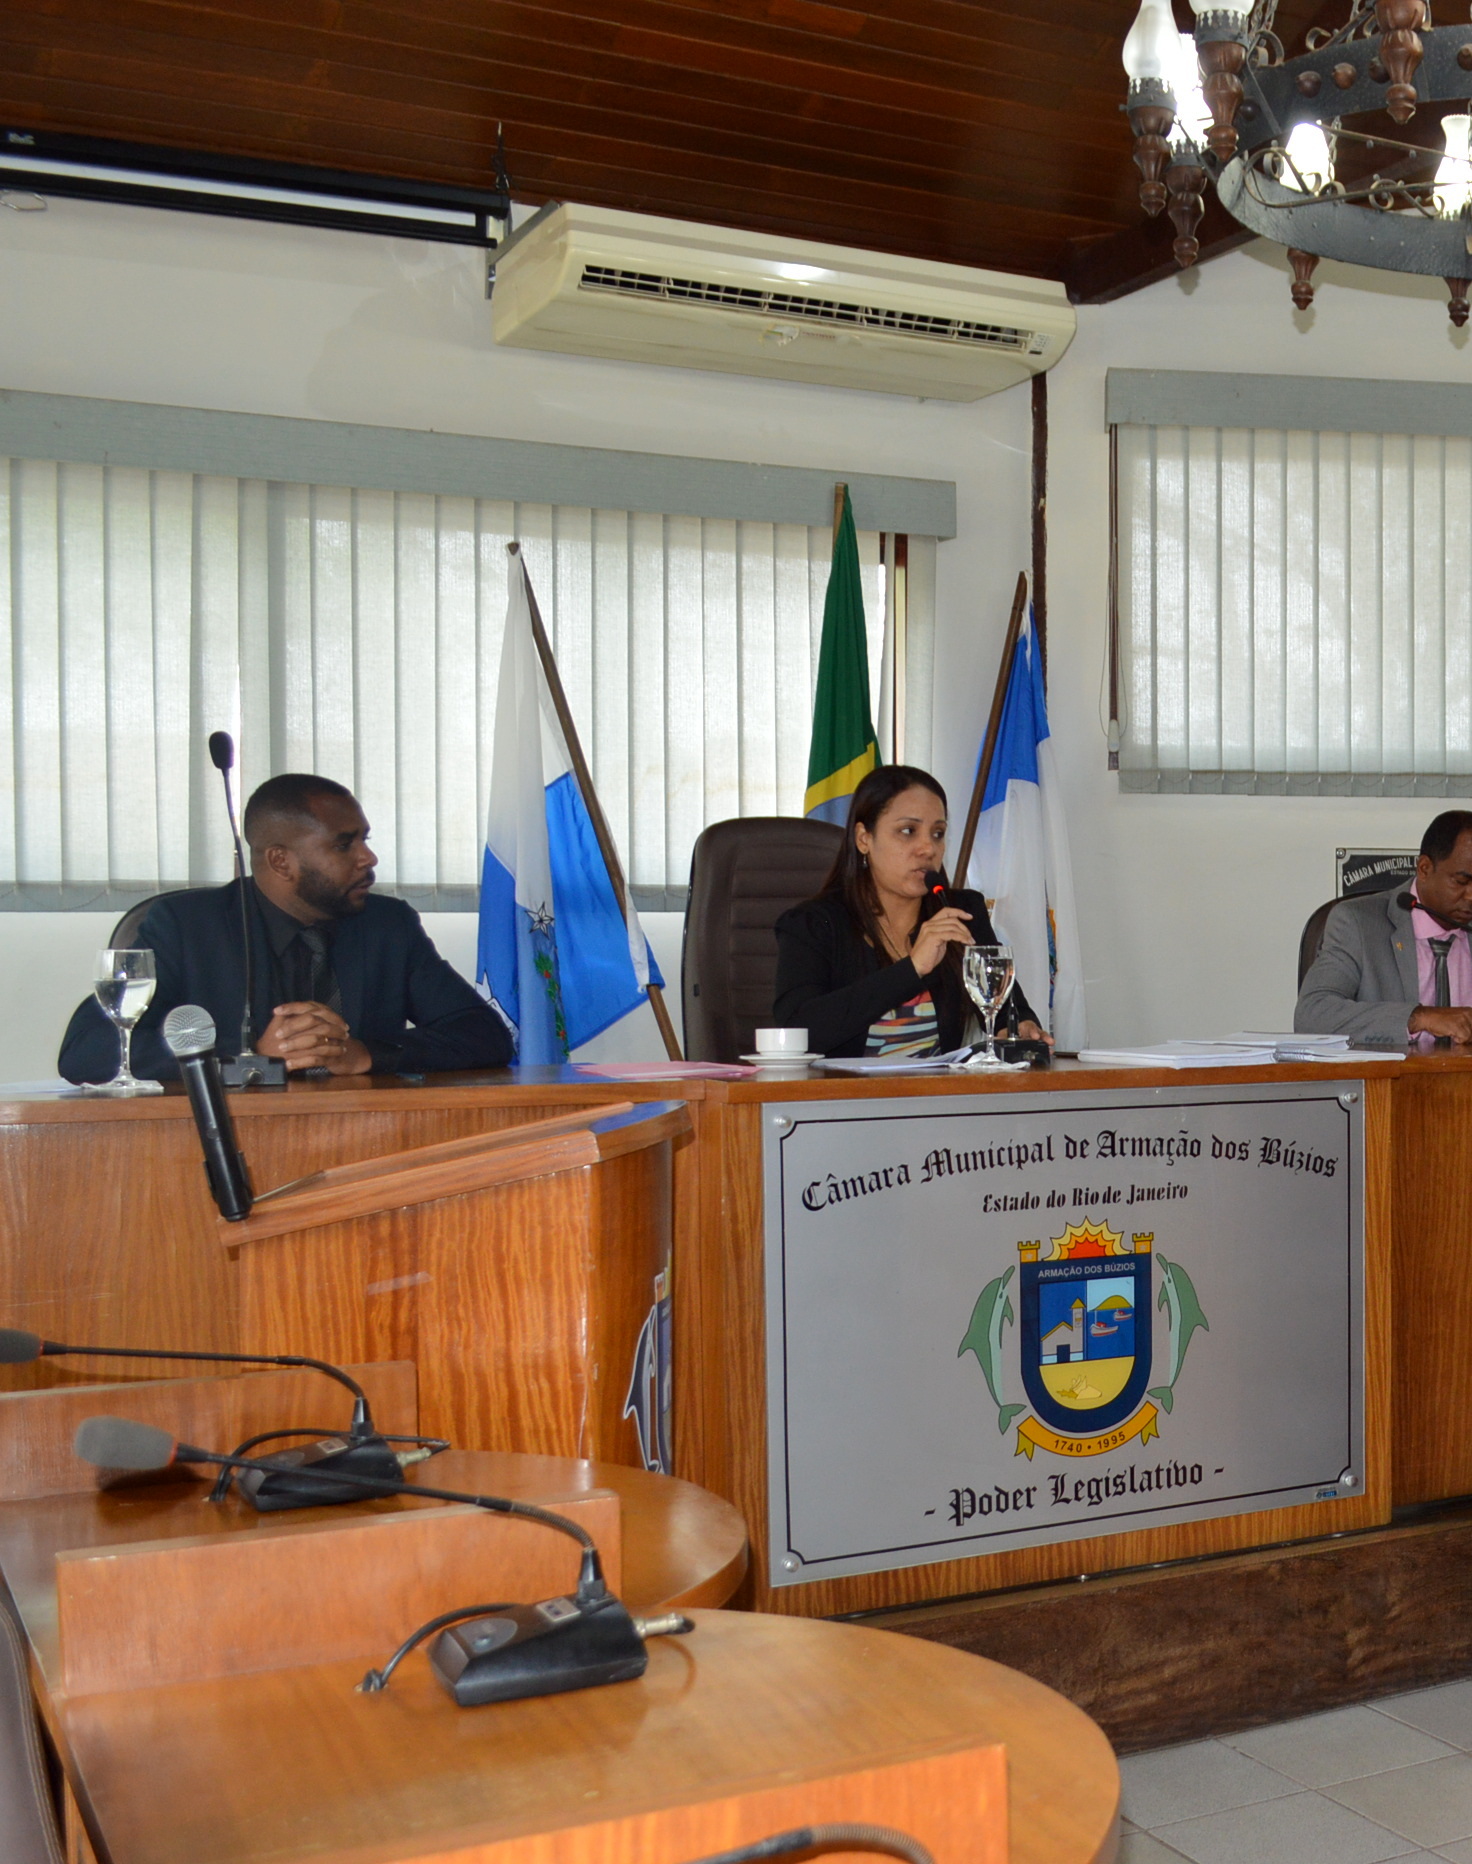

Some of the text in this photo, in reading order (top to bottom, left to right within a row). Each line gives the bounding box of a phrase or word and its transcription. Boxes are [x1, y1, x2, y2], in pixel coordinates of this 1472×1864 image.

[1343, 856, 1419, 887] CÂMARA MUNICIPAL D
[801, 1129, 1339, 1212] Câmara Municipal de Armação dos Búzios
[982, 1181, 1189, 1214] Estado do Rio de Janeiro
[1037, 1261, 1136, 1279] ARMAÇÃO DOS BÚZIOS
[1053, 1430, 1127, 1454] 1740 1995
[948, 1484, 1038, 1527] Poder
[1047, 1459, 1204, 1507] Legislativo
